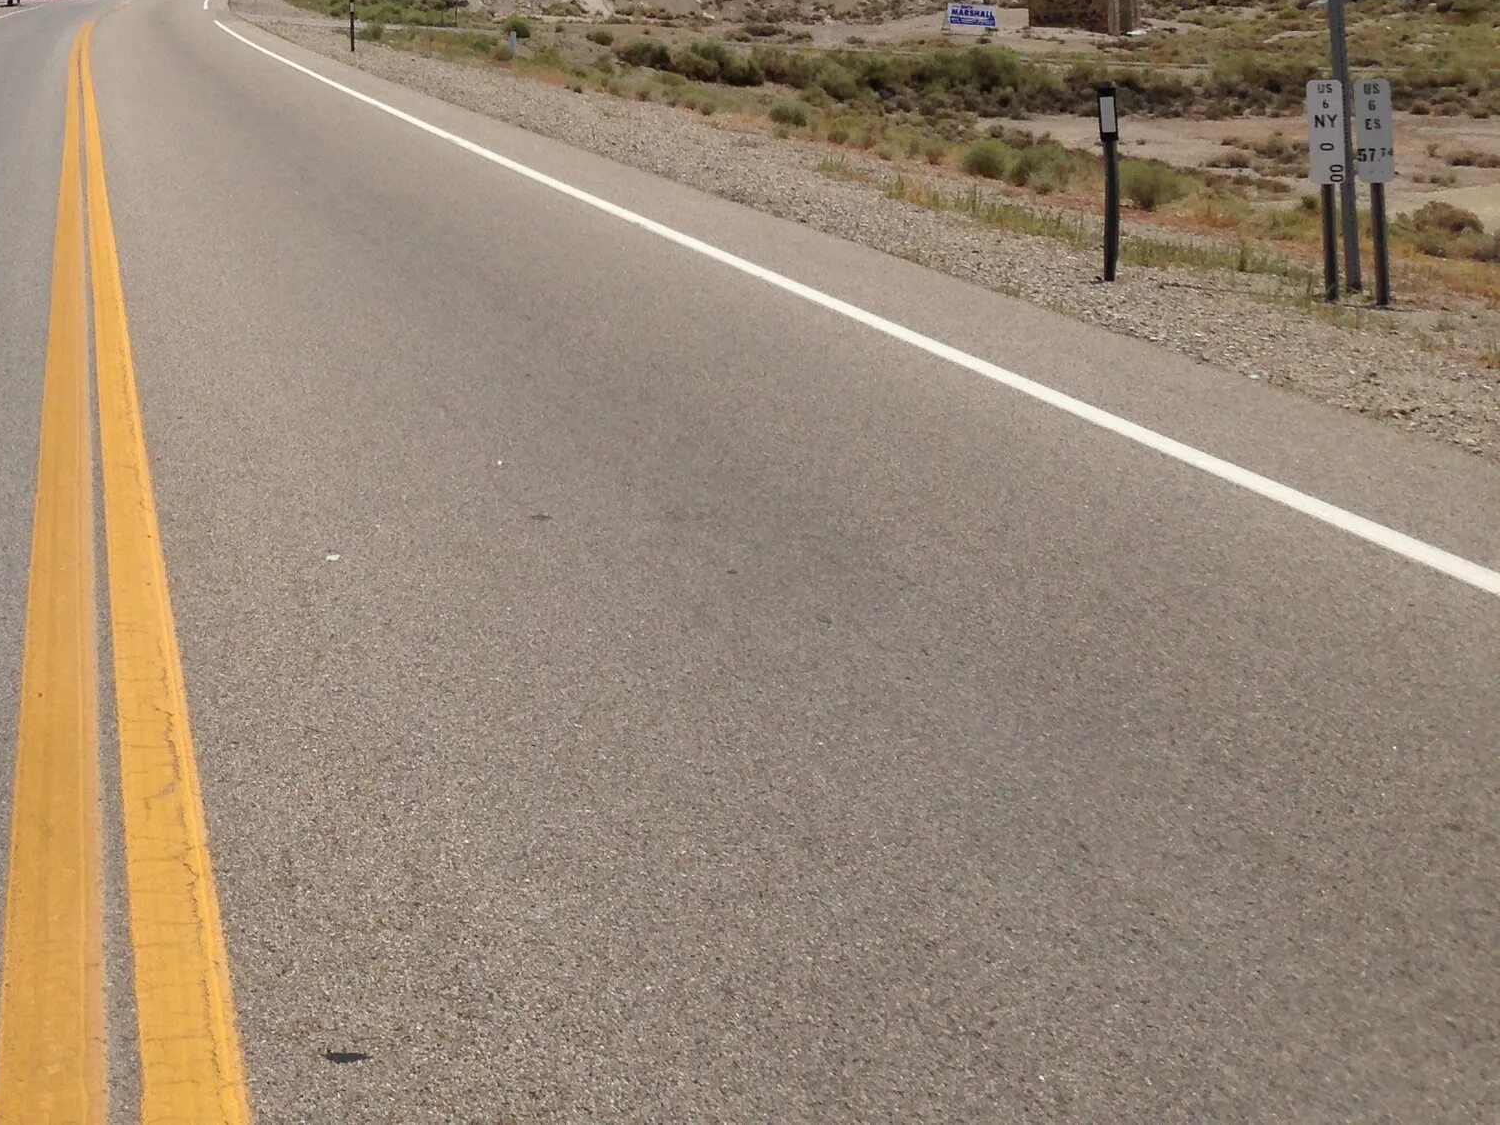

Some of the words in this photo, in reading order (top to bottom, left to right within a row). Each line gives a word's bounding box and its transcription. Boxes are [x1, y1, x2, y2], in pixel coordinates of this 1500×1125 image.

[951, 8, 993, 19] MARSHALL
[1317, 83, 1333, 94] US
[1363, 83, 1381, 95] US
[1322, 99, 1330, 109] 6
[1368, 100, 1376, 111] 6
[1314, 114, 1338, 128] NY
[1365, 118, 1381, 130] ES
